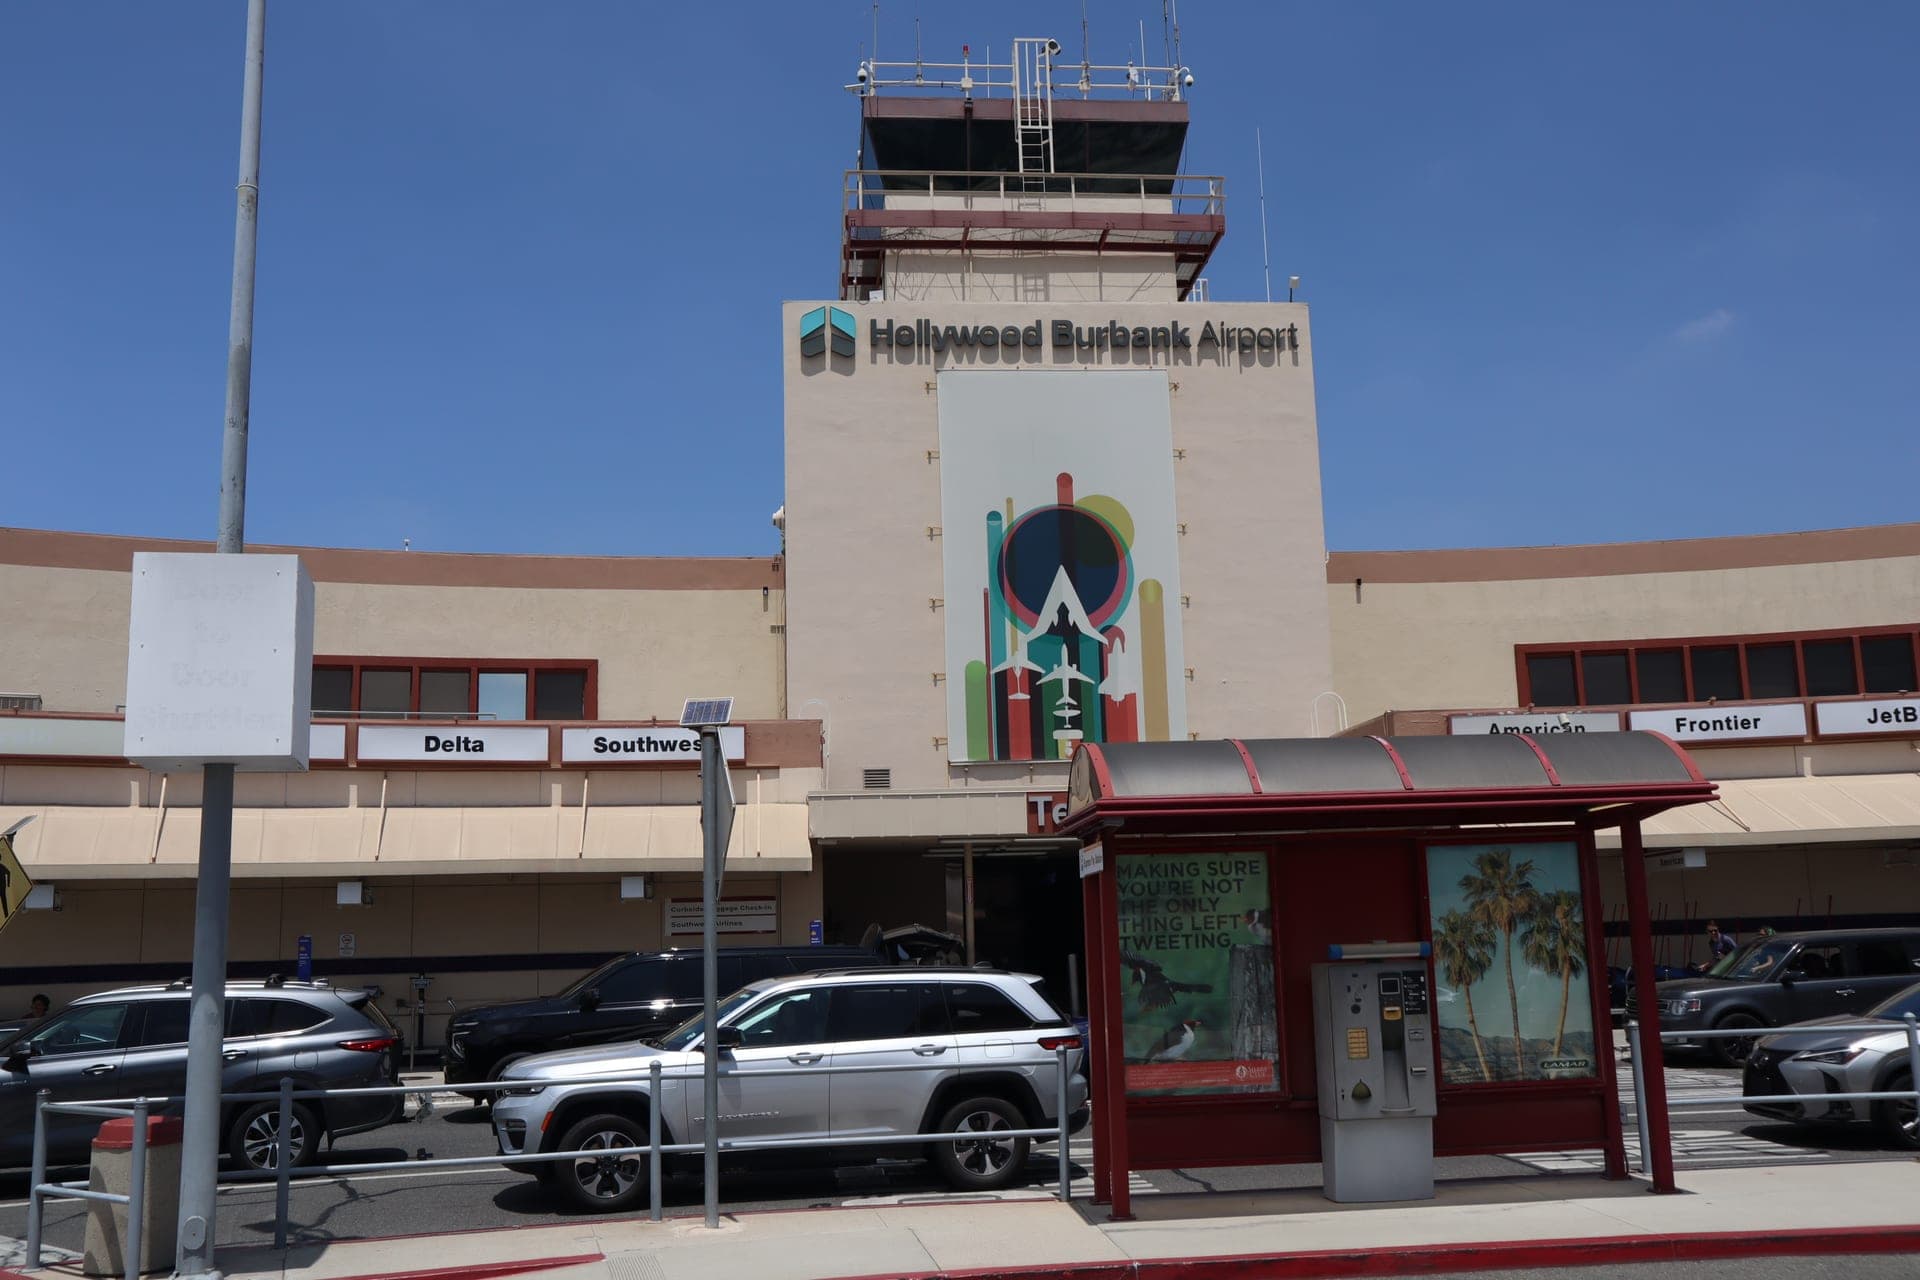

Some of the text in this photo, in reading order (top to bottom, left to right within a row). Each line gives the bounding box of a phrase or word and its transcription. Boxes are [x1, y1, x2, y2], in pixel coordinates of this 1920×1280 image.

[870, 318, 1299, 354] Hollywood Burbank Airport
[1675, 715, 1761, 733] Frontier
[424, 735, 485, 753] Delta
[593, 736, 703, 753] Southwes
[1117, 860, 1261, 880] MAKING SURE
[1117, 878, 1245, 897] YOU'RE NOT
[1119, 896, 1221, 915] THE ONLY
[671, 919, 704, 928] Southwe
[1119, 913, 1242, 934] THING LEFT
[1543, 1060, 1586, 1069] LAMAR
